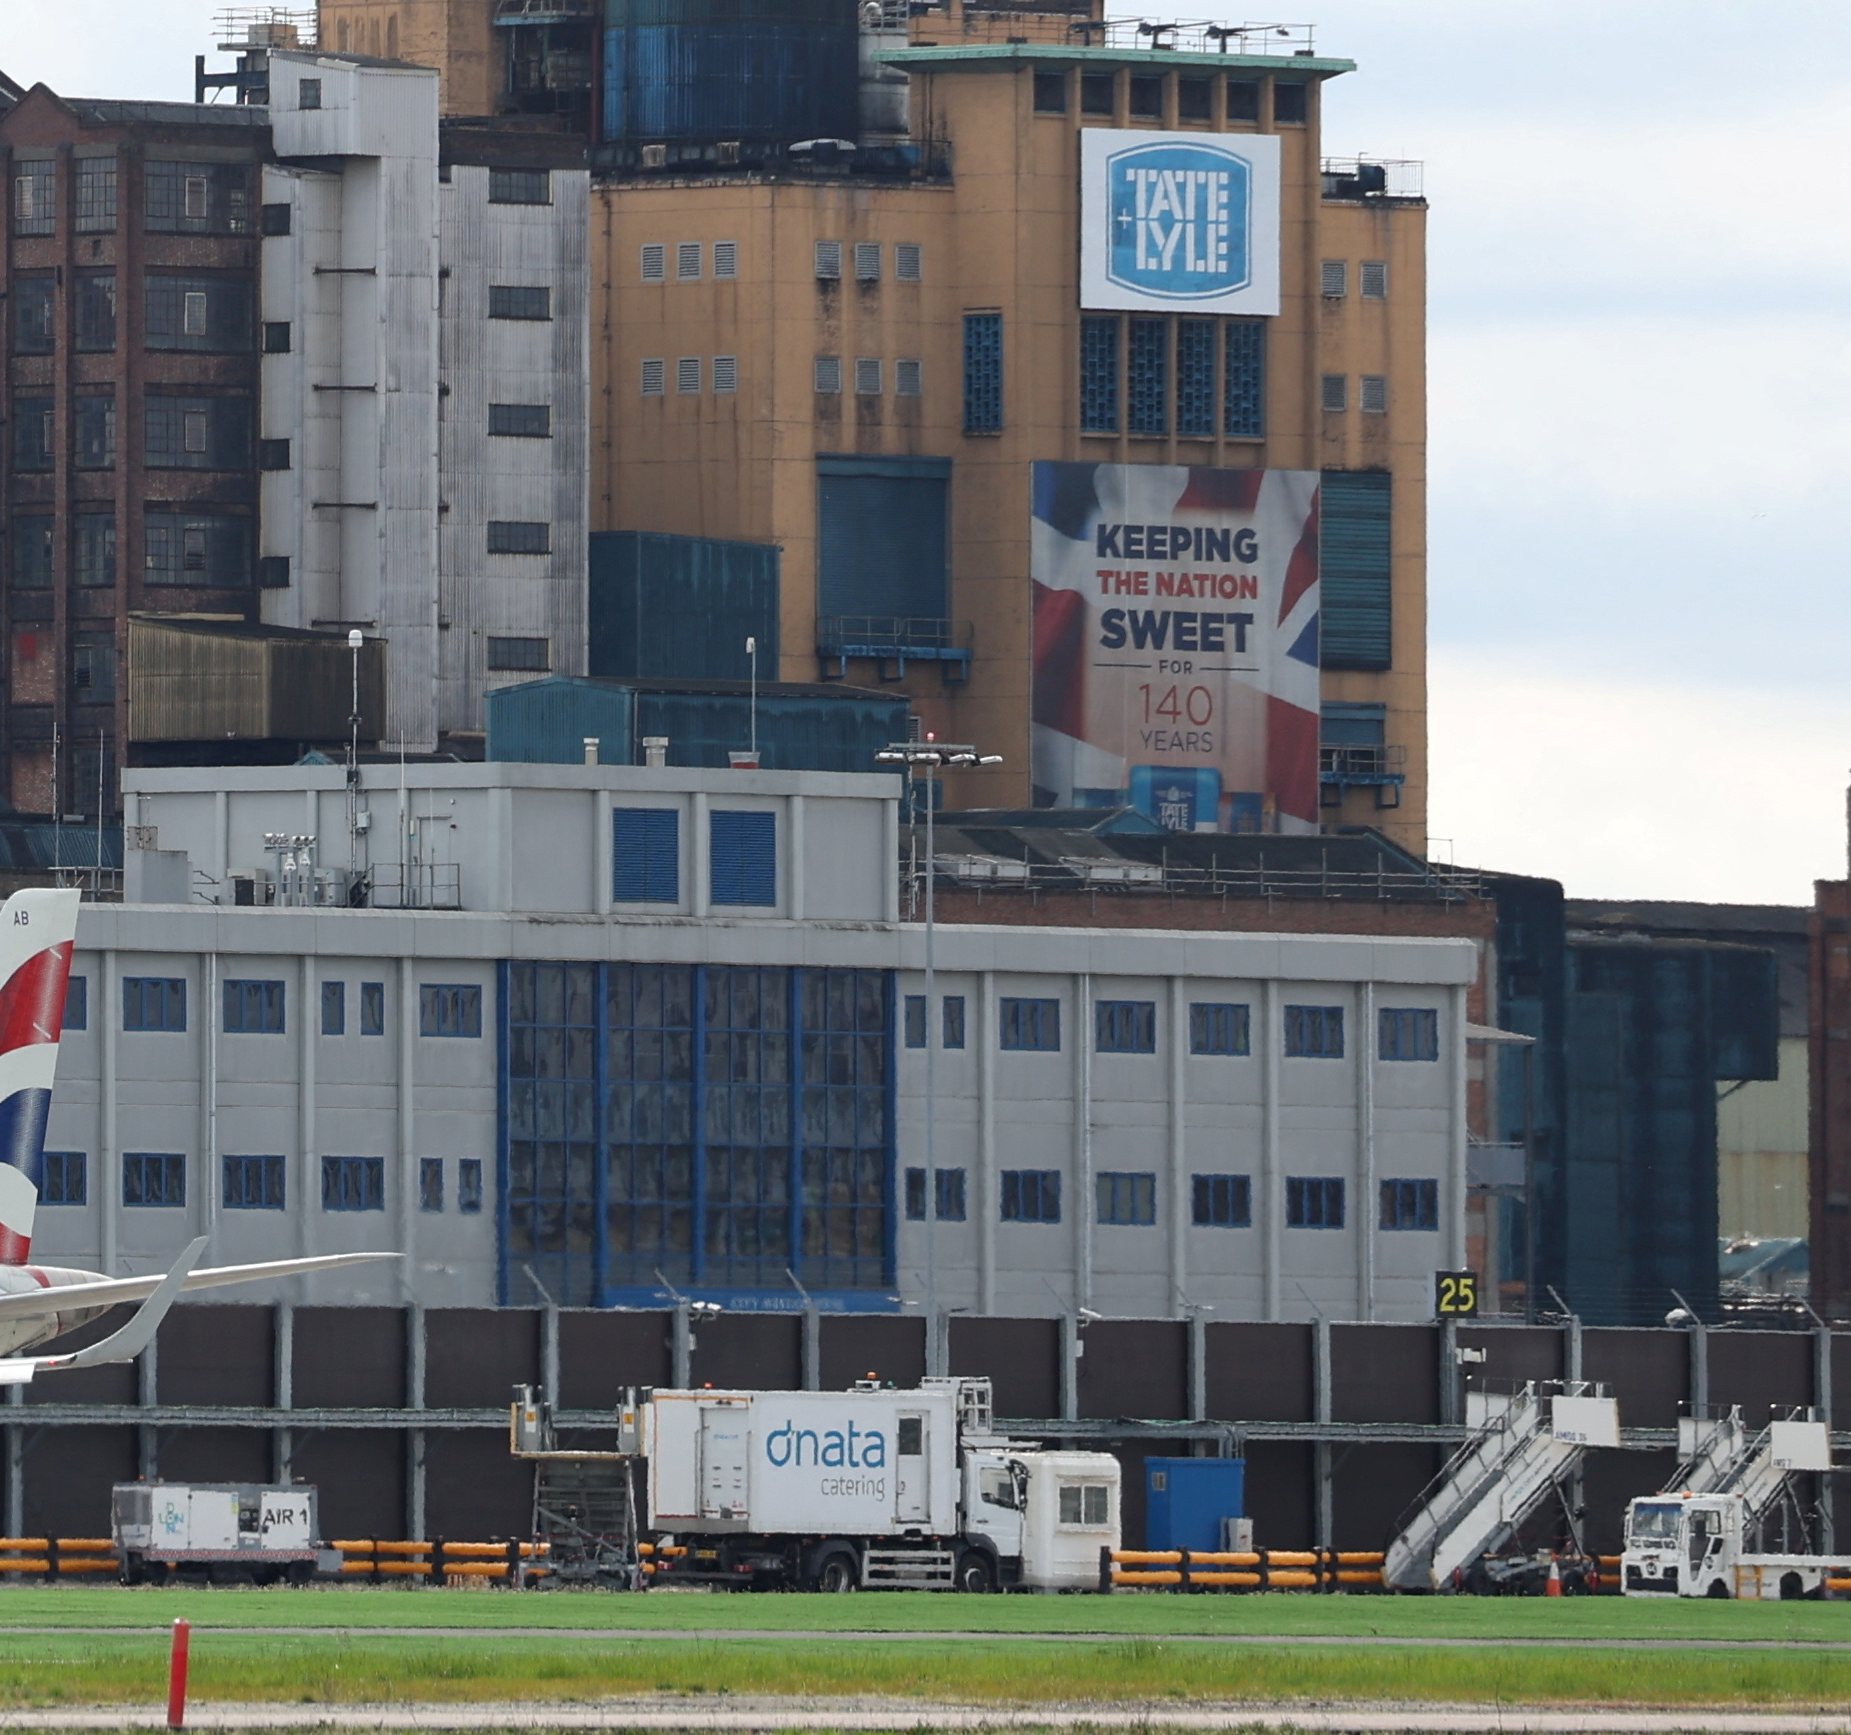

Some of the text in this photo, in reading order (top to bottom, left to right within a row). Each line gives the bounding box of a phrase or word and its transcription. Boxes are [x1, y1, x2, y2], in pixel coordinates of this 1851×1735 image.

[1125, 168, 1229, 222] TATE
[1135, 219, 1228, 273] LYLE
[1096, 524, 1258, 565] KEEPING
[1096, 570, 1258, 600] THE NATION
[1099, 608, 1254, 653] SWEET
[1159, 659, 1193, 675] FOR
[1139, 683, 1213, 726] 140
[1140, 729, 1213, 754] YEARS
[1159, 802, 1188, 817] TATE
[14, 910, 29, 926] AB
[1439, 1277, 1475, 1312] 25
[765, 1419, 886, 1469] dnata
[820, 1475, 886, 1503] catering
[262, 1508, 308, 1526] AIR 1
